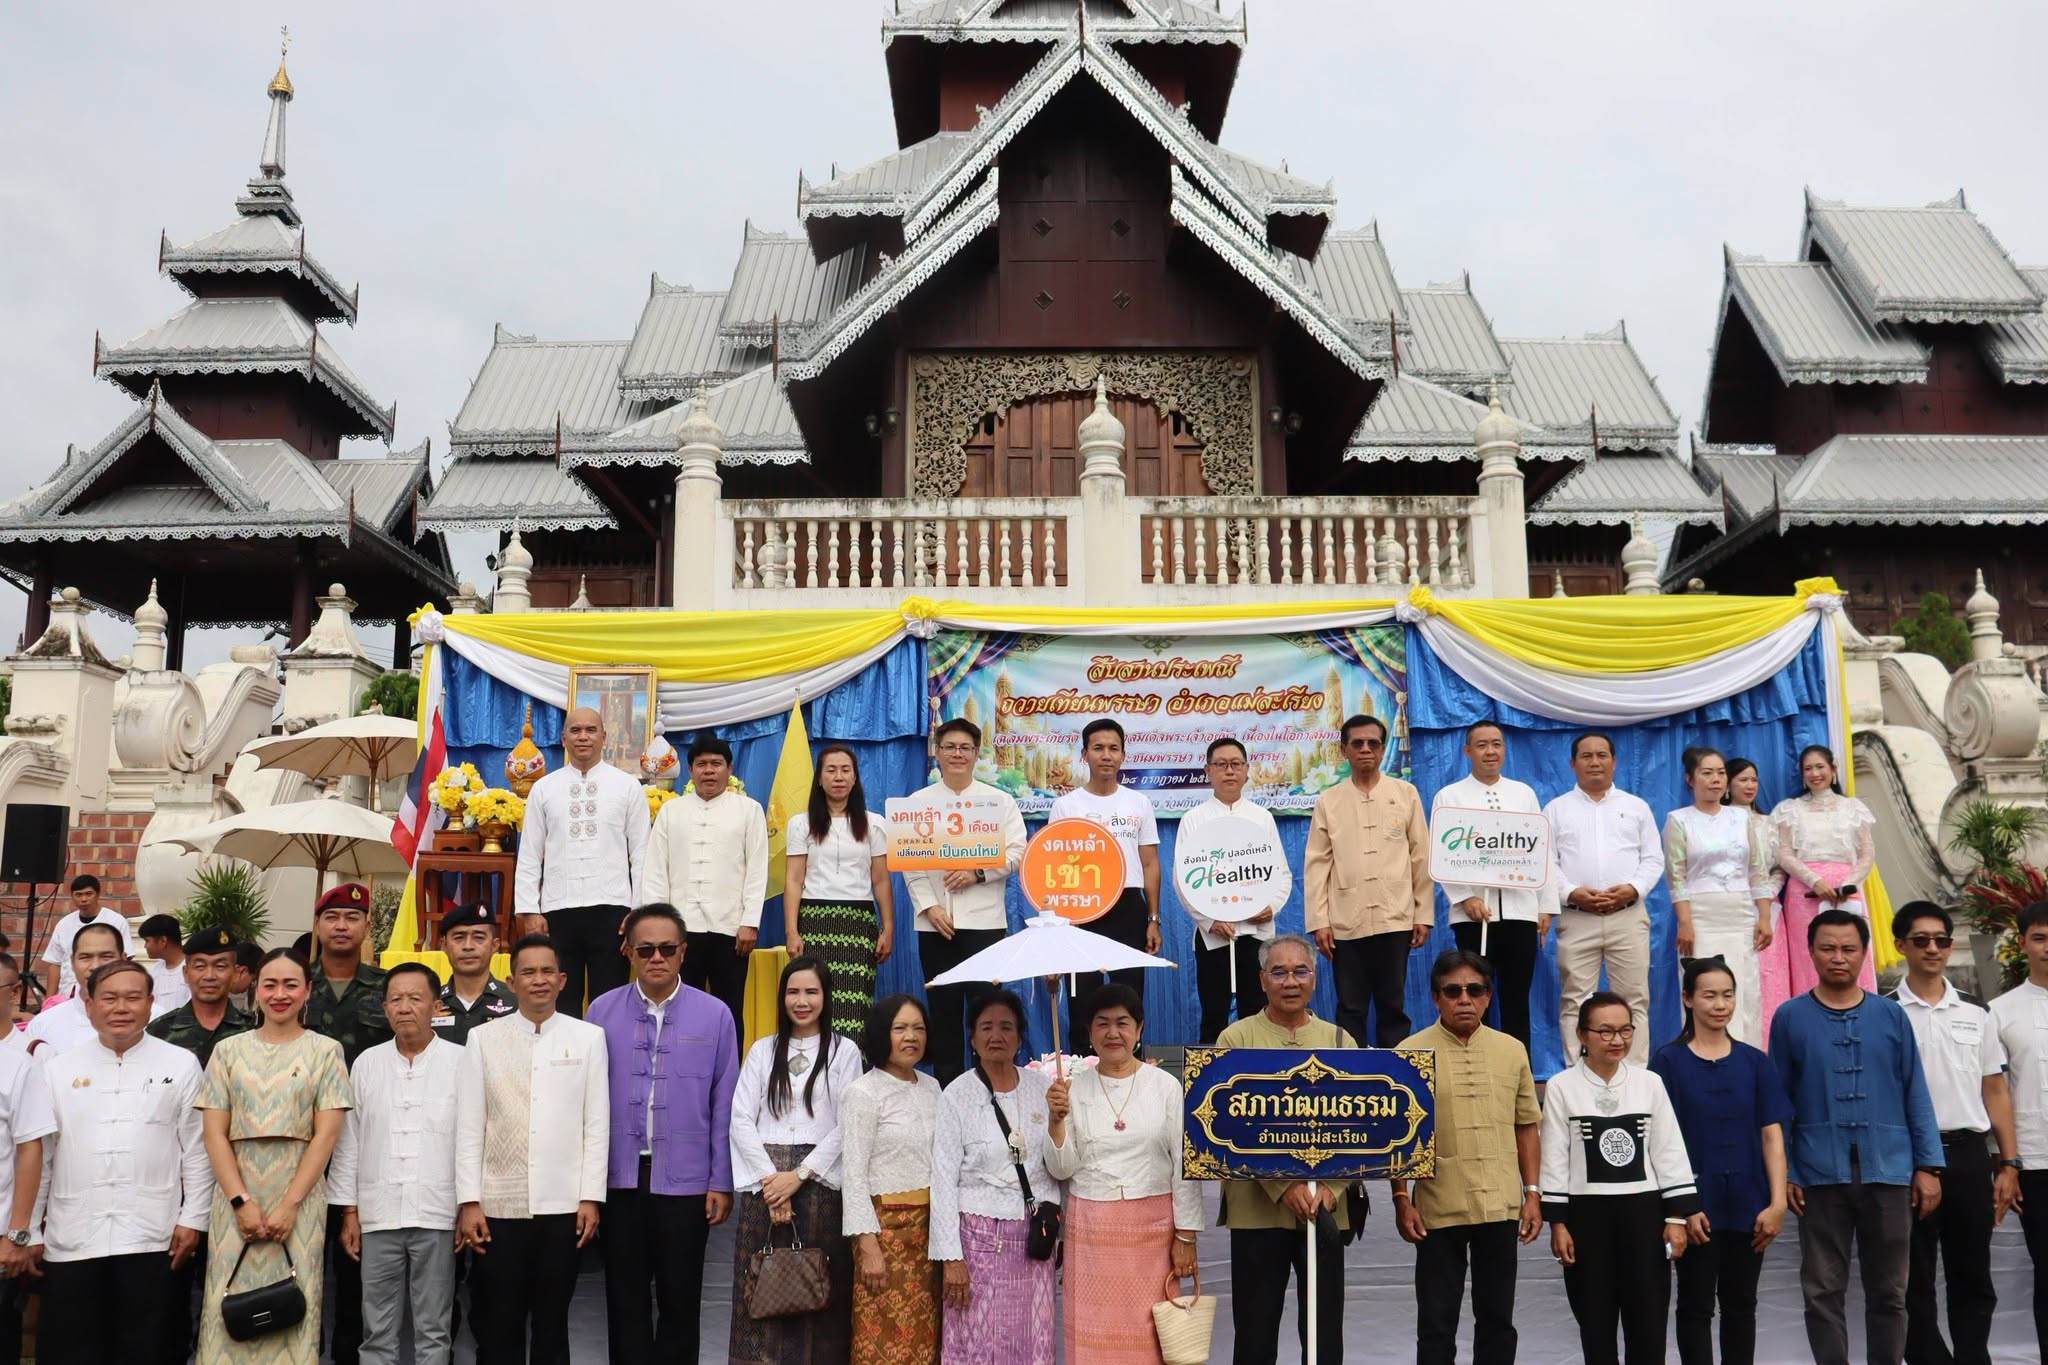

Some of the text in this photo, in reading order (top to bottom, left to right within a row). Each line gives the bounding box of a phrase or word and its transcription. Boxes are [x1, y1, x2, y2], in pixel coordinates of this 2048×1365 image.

[1088, 654, 1242, 682] สืบสานประเพณี
[1000, 685, 1325, 716] ถวายเทียนพรรษา อำเภอแม่สะเรียง
[993, 729, 1080, 745] เฉลิมพระเกียรติ
[1242, 725, 1341, 742] เนื่องในโอกาสมหา
[892, 807, 998, 836] งดเหล้า 3 เดือน
[940, 844, 999, 857] เป็นคนใหม่
[1042, 833, 1106, 852] งดเหล้า
[1441, 826, 1538, 852] Healthy
[1045, 854, 1101, 889] เข้า
[1184, 855, 1207, 865] สังคม
[1185, 864, 1273, 890] Healthy
[1045, 894, 1101, 907] พรรษา
[1228, 1086, 1397, 1117] สภาวัฒนธรรม
[1258, 1128, 1368, 1144] อำเภอแม่สะเรียง
